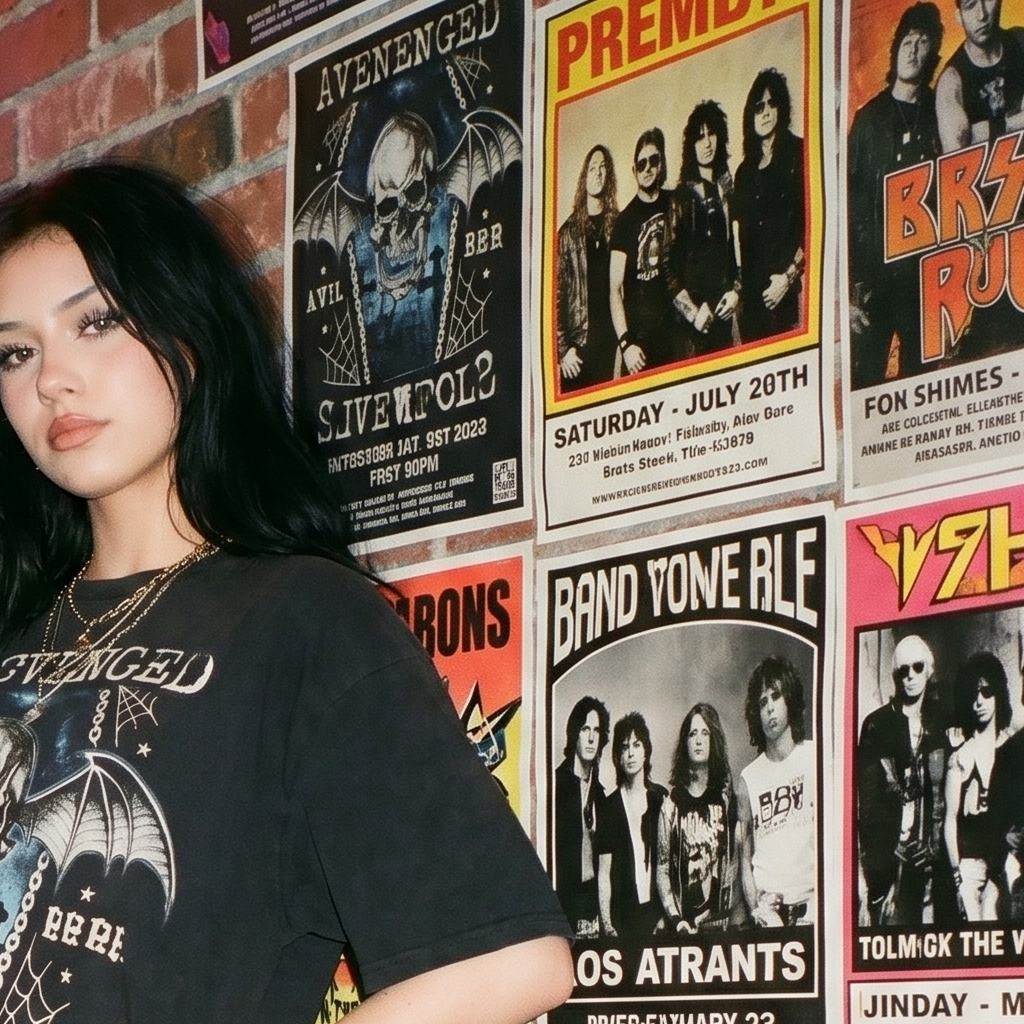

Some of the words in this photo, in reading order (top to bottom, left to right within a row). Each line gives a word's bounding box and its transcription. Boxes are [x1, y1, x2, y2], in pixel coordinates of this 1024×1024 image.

[914, 366, 1003, 408] SHIMES
[554, 401, 665, 449] SATURDAY
[685, 382, 742, 416] JULY
[749, 364, 808, 400] 20TH
[426, 427, 452, 450] 9ST
[454, 417, 487, 442] 2023
[882, 420, 901, 435] ARE
[404, 453, 439, 478] 90PM
[553, 563, 639, 667] BAND
[959, 930, 1005, 957] THE
[572, 949, 624, 987] OS
[635, 941, 807, 986] ATRANTS
[863, 993, 968, 1019] JINDAY
